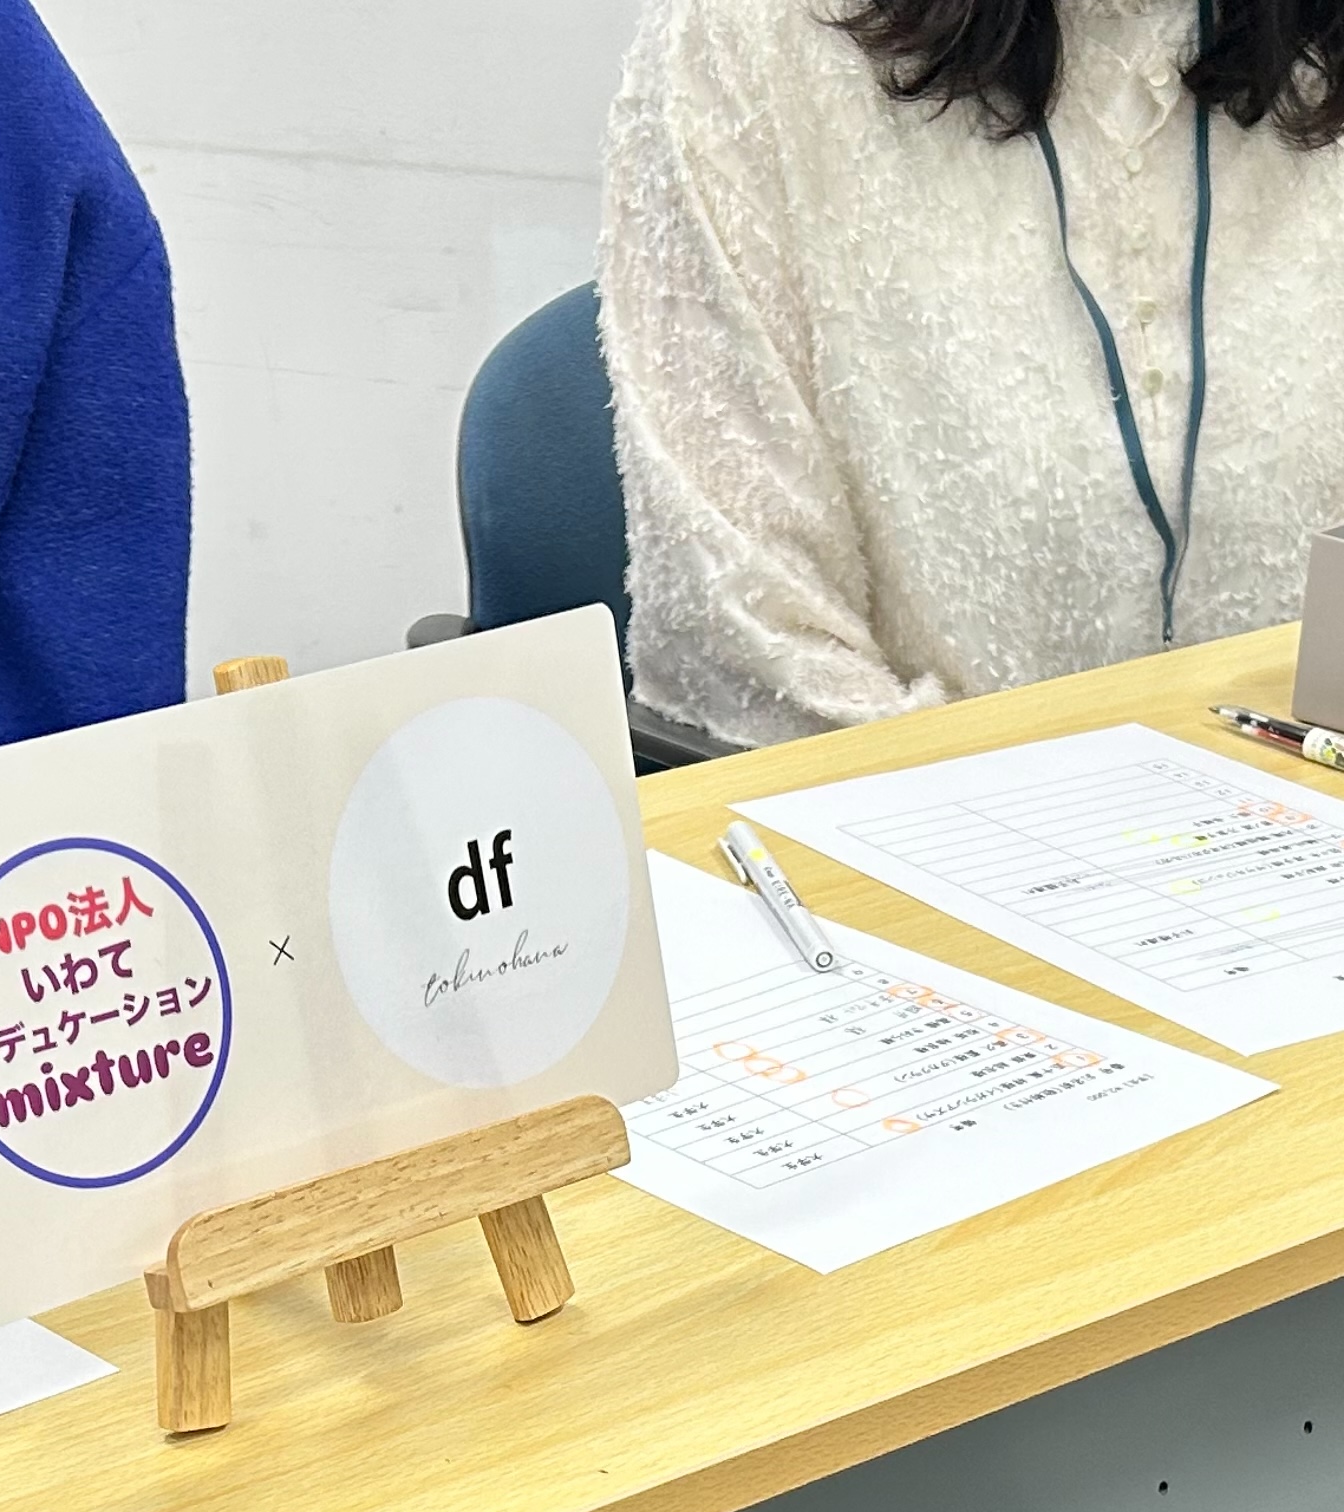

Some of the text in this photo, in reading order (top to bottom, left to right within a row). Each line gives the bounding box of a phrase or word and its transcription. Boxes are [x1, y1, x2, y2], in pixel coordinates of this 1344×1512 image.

[447, 829, 514, 921] df
[21, 941, 134, 1004] いわて
[422, 929, 569, 1008] tokinohana
[668, 1101, 709, 1119] 大学生
[695, 1114, 736, 1131] 大学生
[725, 1127, 765, 1144] 大学生
[752, 1139, 793, 1157] 大学生
[781, 1152, 823, 1170] 大学生
